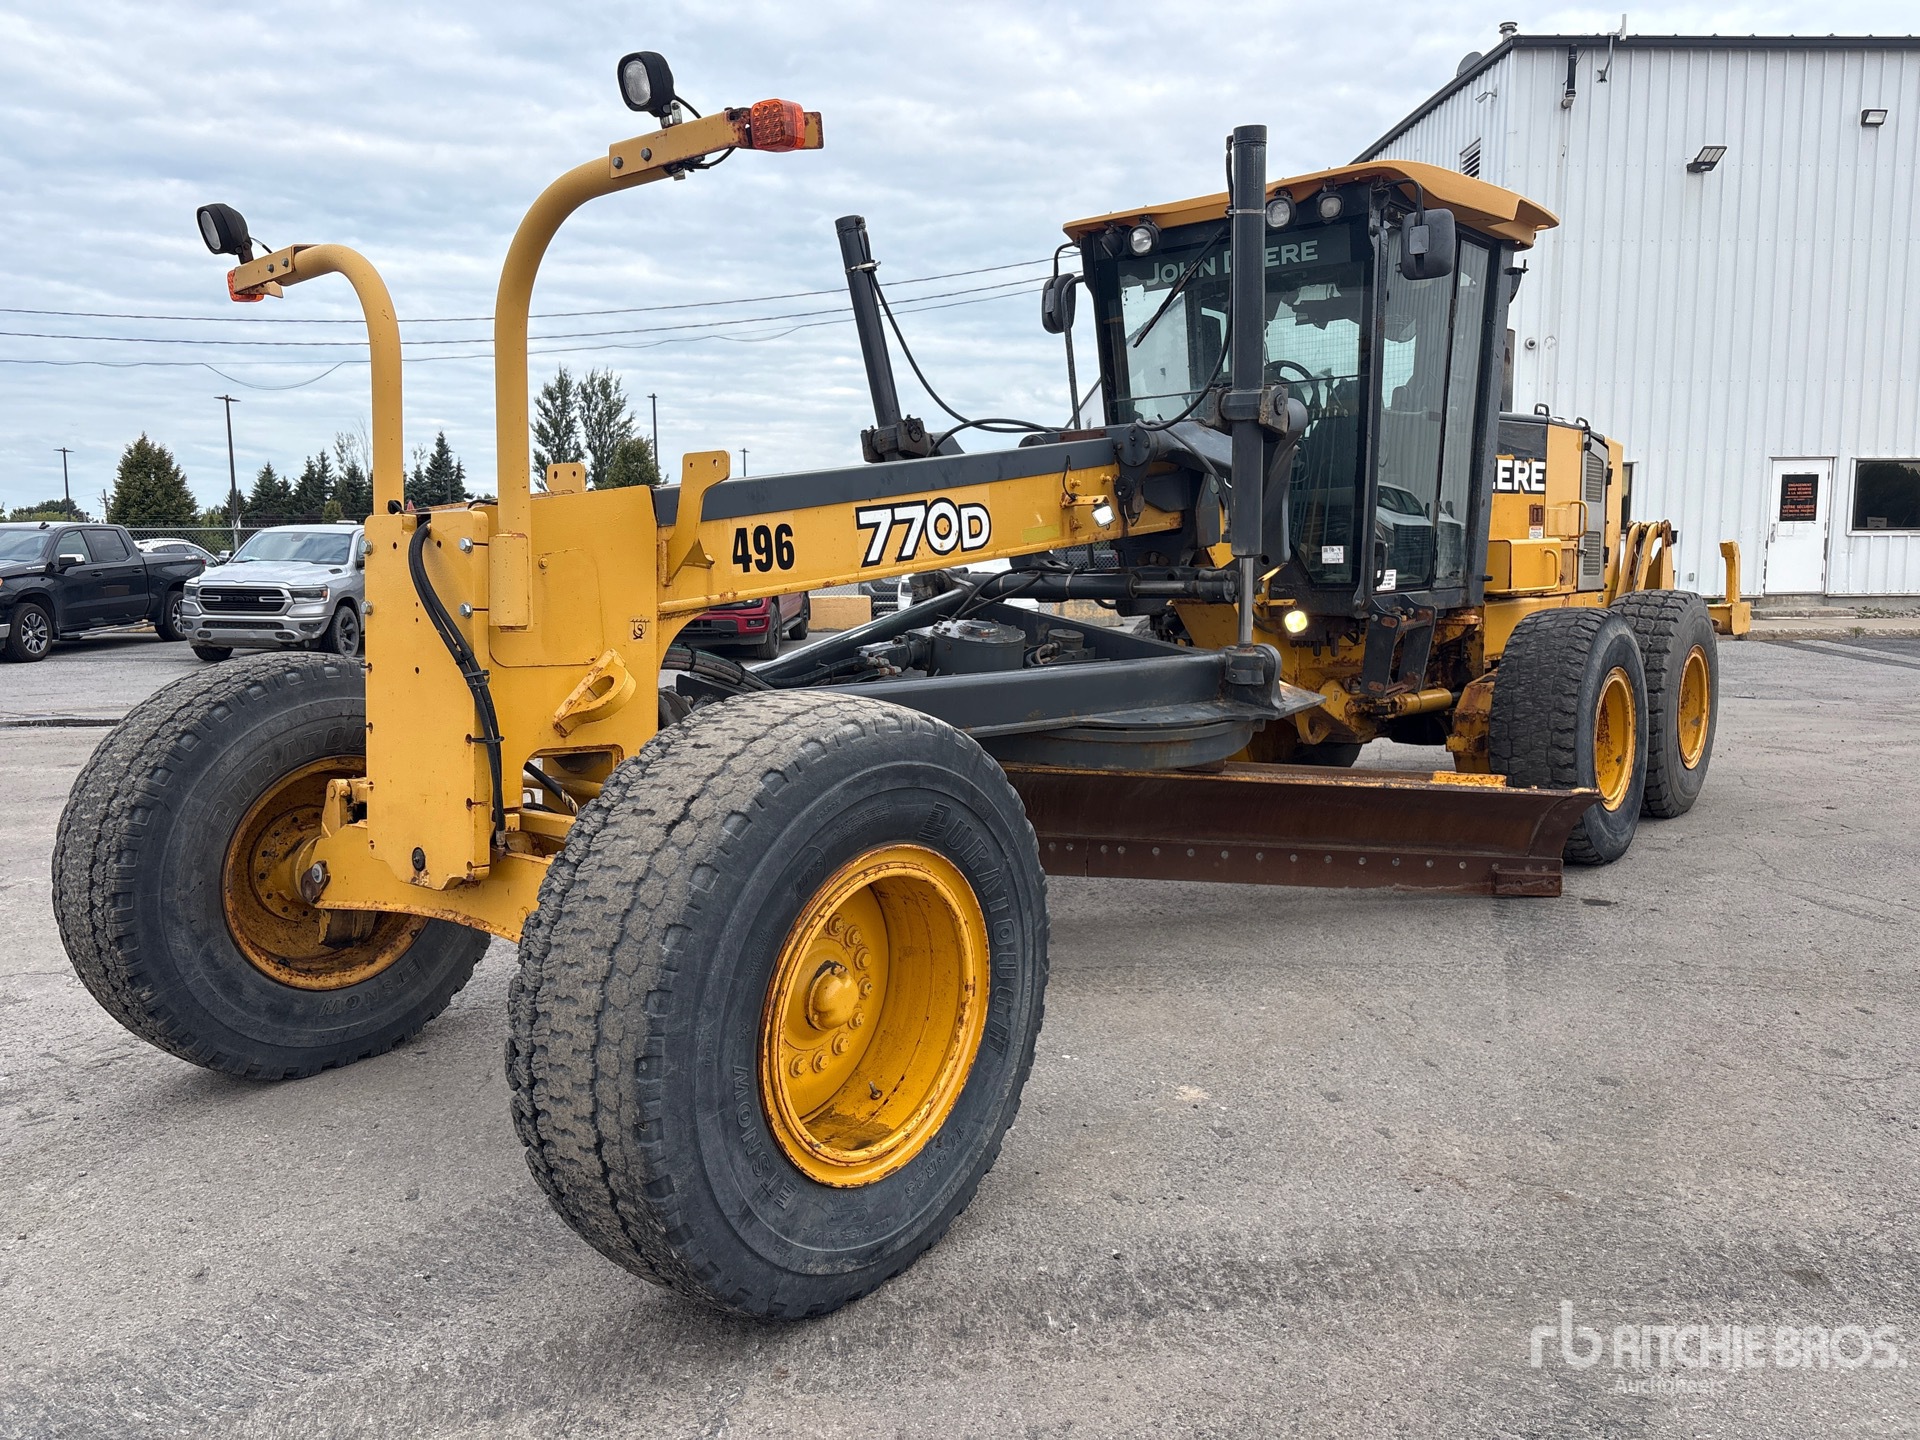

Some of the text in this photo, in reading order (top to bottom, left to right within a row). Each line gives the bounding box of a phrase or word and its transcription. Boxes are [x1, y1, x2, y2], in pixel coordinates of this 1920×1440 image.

[1223, 240, 1318, 274] ERE
[1493, 459, 1546, 491] ERE
[732, 523, 795, 573] 496
[855, 497, 991, 567] 770D
[918, 802, 1017, 1055] DURATOUGH
[733, 1065, 799, 1210] ETSNOW
